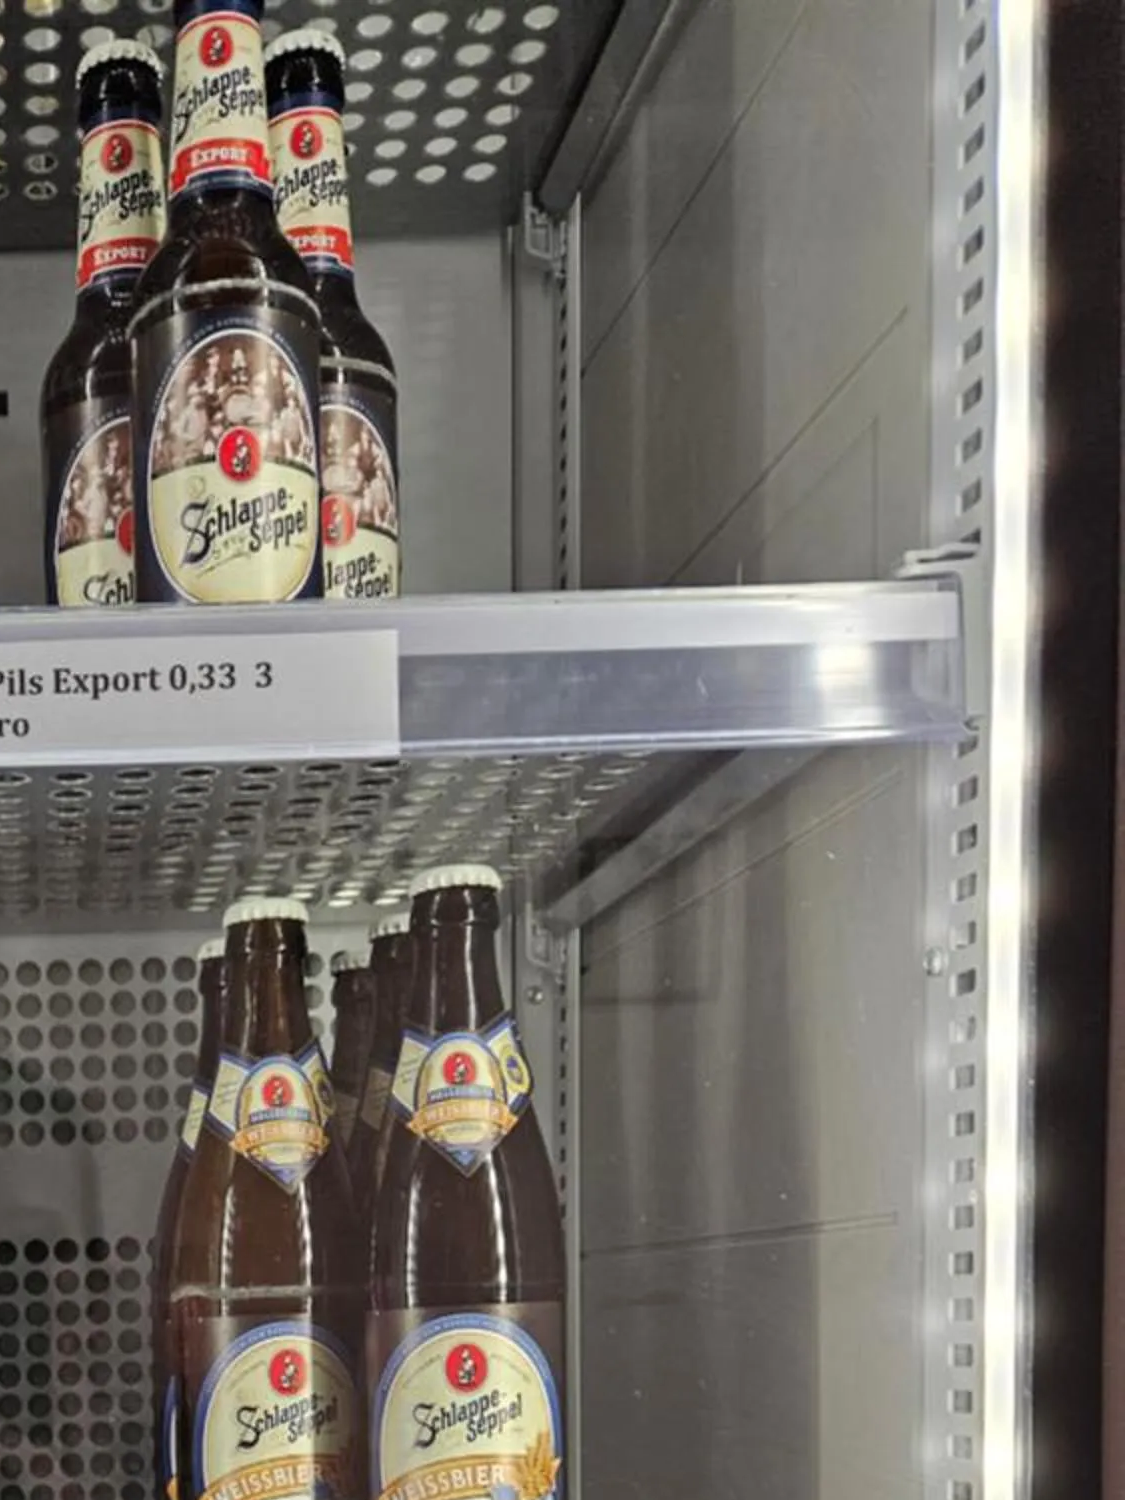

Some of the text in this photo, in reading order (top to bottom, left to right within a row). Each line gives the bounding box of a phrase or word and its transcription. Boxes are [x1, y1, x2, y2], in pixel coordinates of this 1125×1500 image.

[218, 88, 264, 117] Seppe
[249, 502, 308, 552] Seppel
[326, 551, 382, 590] lappe-
[53, 666, 161, 700] Export
[169, 662, 236, 694] 0,33
[255, 662, 272, 688] 3
[466, 1393, 523, 1443] Seppel
